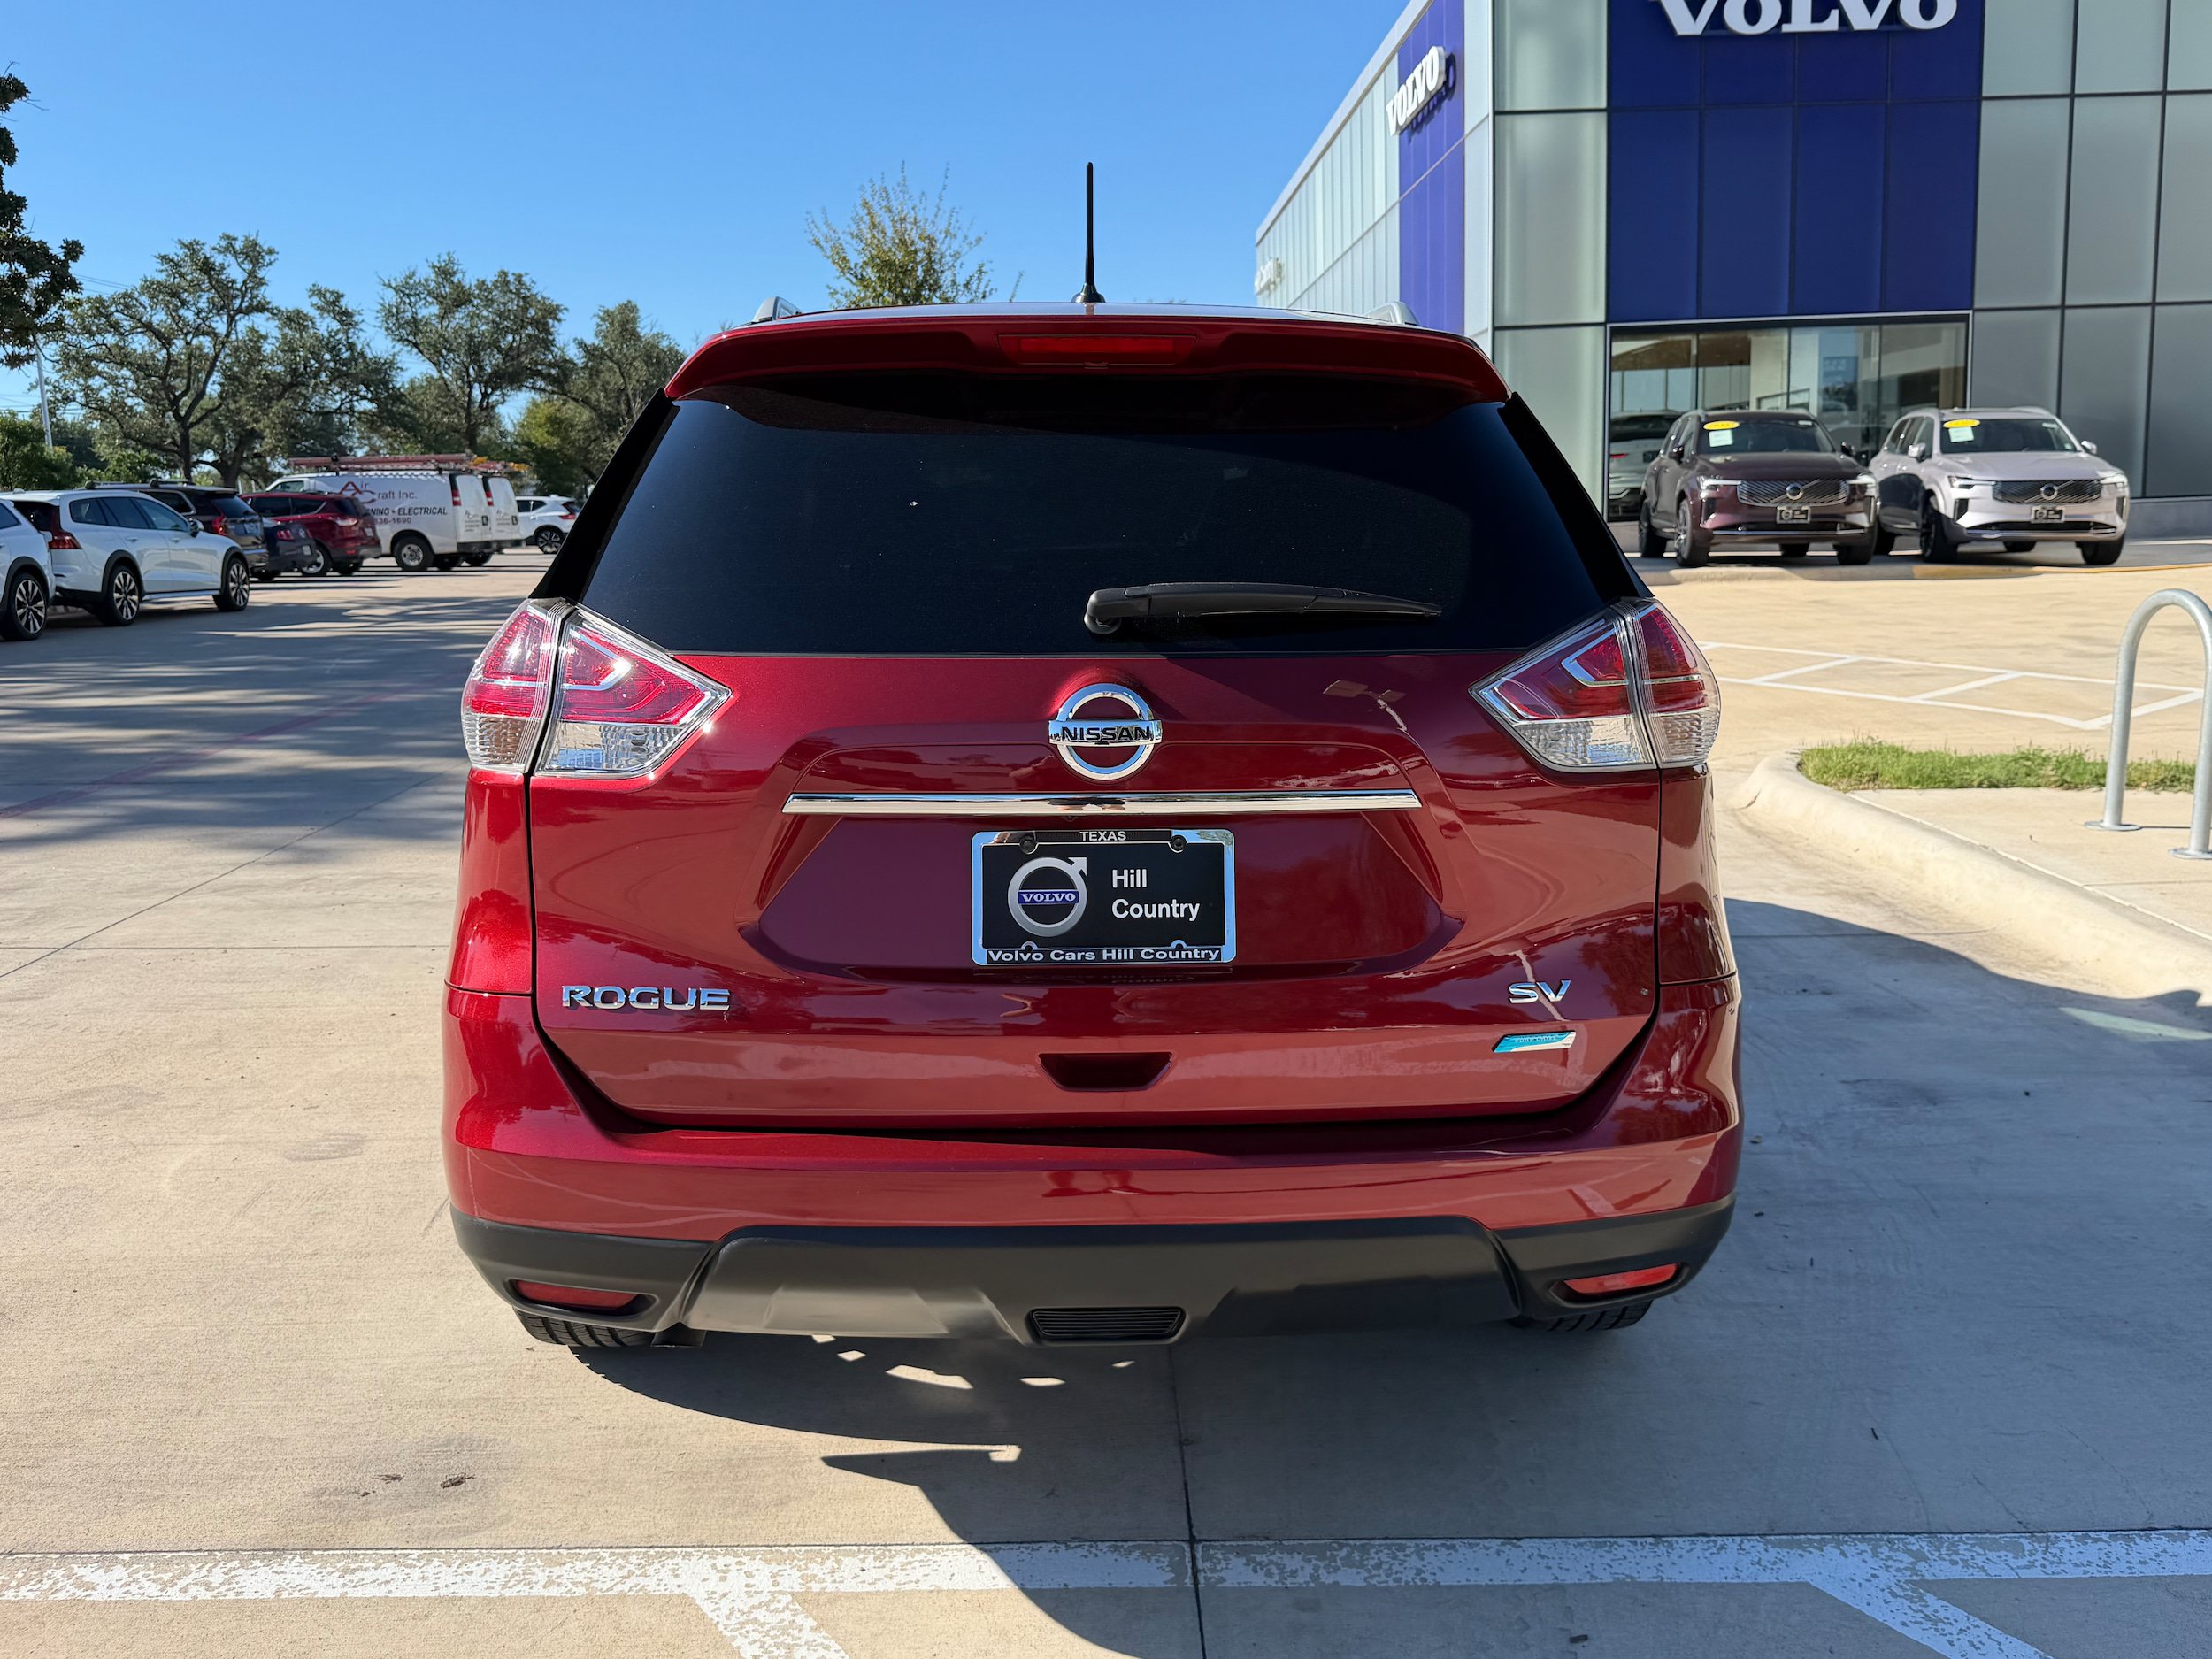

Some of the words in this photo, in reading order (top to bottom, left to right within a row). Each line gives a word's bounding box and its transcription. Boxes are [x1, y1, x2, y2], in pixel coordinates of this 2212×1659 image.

[1657, 0, 1957, 35] VOLVO
[1386, 46, 1440, 136] VOLVO
[398, 490, 418, 500] Inc.
[367, 507, 389, 516] NING
[397, 506, 448, 516] ELECTRICAL
[1062, 726, 1149, 741] NISSAN
[1079, 831, 1126, 841] TEXAS
[1111, 869, 1148, 888] Hill
[1020, 892, 1076, 902] VOLVO
[1111, 899, 1200, 921] Country
[988, 950, 1044, 962] Volvo
[1049, 949, 1095, 961] Cars
[1102, 949, 1133, 960] Hill
[1141, 949, 1219, 960] Country
[562, 985, 730, 1010] ROGUE
[1509, 979, 1571, 1004] SV
